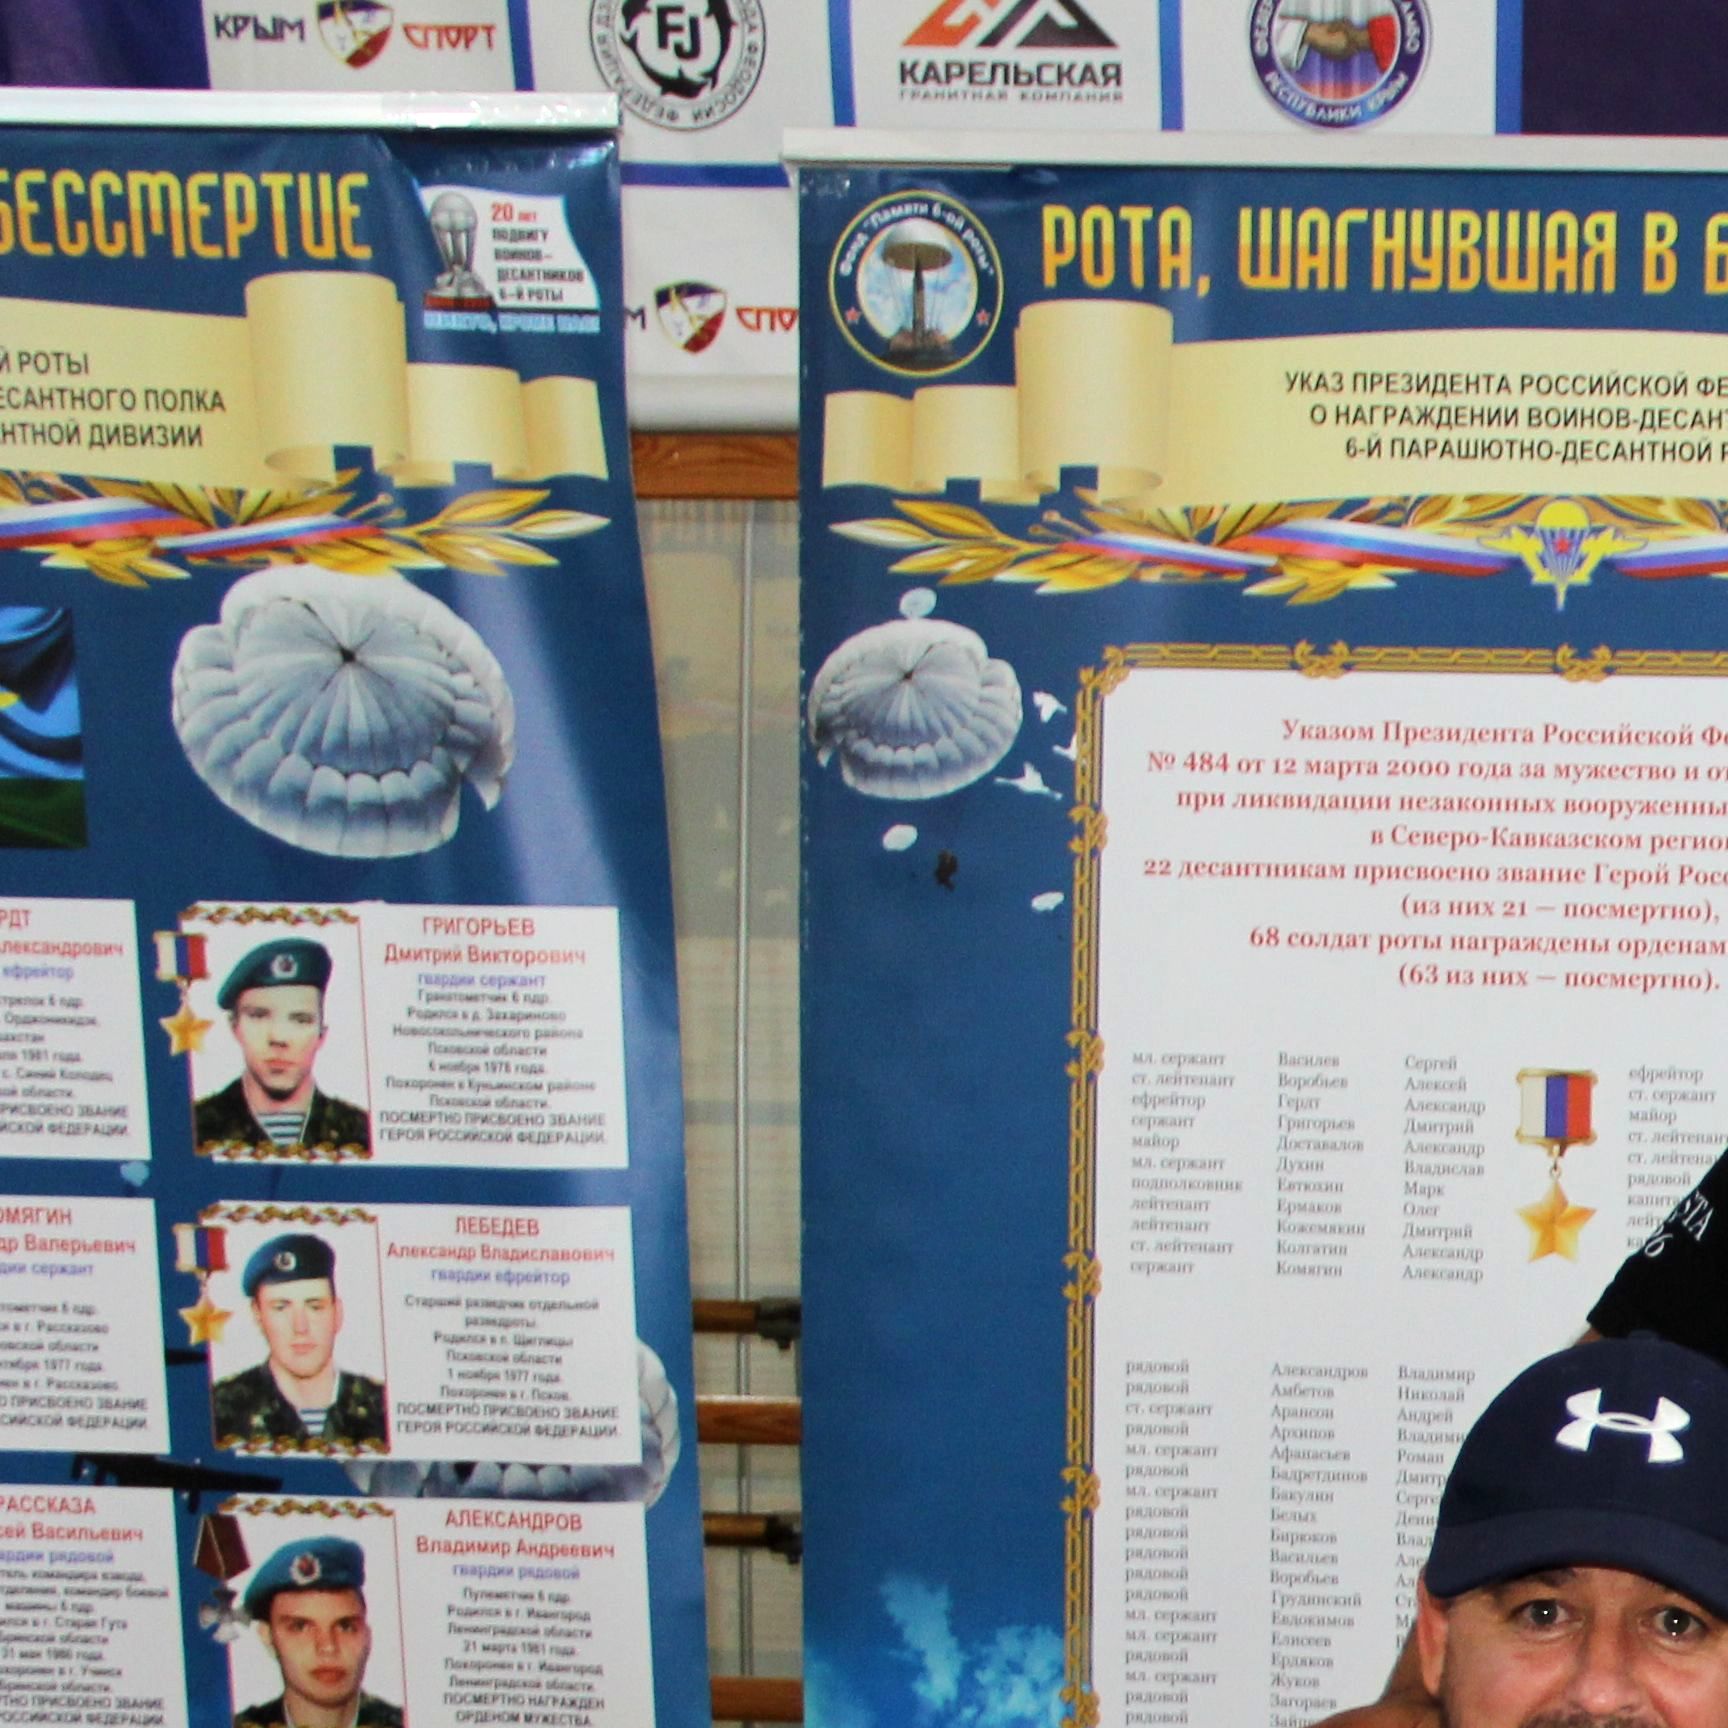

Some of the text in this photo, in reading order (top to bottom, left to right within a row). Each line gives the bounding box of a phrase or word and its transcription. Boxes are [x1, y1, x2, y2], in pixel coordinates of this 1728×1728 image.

[214, 15, 497, 51] КРЫМ СПОРТ
[656, 7, 701, 60] FJ
[899, 60, 1123, 88] КАРЕЛЬСКАЯ
[1043, 205, 1211, 301] РОТА,
[1238, 206, 1617, 294] ШАГНУВШАЯ
[1642, 210, 1678, 294] В
[17, 350, 90, 376] РОТЫ
[1285, 371, 1344, 393] УКАЗ
[1352, 372, 1512, 399] ПРЕЗИДЕНТА
[1520, 374, 1688, 398] РОССИЙСКОЙ
[143, 388, 227, 413] ПОЛКА
[1310, 404, 1327, 425] О
[1335, 404, 1519, 431] НАГРАЖДЕНИИ
[88, 423, 203, 450] ДИВИЗИИ
[1345, 437, 1382, 459] 6-Й
[1390, 437, 1712, 465] ПАРАШЮТНО-ДЕСАНТНОЙ
[1283, 719, 1374, 741] Указом
[1383, 720, 1534, 748] Президента
[1543, 723, 1694, 746] Российской
[1148, 751, 1176, 772] №
[1183, 751, 1229, 773] 484
[1237, 759, 1262, 774] от
[1274, 758, 1297, 775] 12
[1305, 759, 1379, 781] марта
[1386, 760, 1451, 777] 2000
[1458, 762, 1512, 780] года
[1519, 763, 1546, 779] за
[1554, 764, 1677, 785] мужество
[1684, 766, 1699, 781] и
[1177, 792, 1225, 813] при
[1232, 793, 1391, 812] ликвидации
[1399, 796, 1555, 814] незаконных
[1371, 830, 1384, 845] в
[1390, 825, 1642, 852] Северо-Кавказском
[1143, 860, 1172, 876] 22
[1178, 861, 1345, 880] десантникам
[1354, 864, 1490, 886] присвоено
[1497, 867, 1586, 884] звание
[1594, 863, 1669, 890] Герой
[1401, 895, 1719, 925] (из них 21 посмертно),
[1249, 927, 1280, 947] 68
[1287, 932, 1368, 950] солдат
[1378, 934, 1442, 955] роты
[1450, 935, 1610, 957] награждены
[1398, 963, 1720, 995] (63 из них посмертно).
